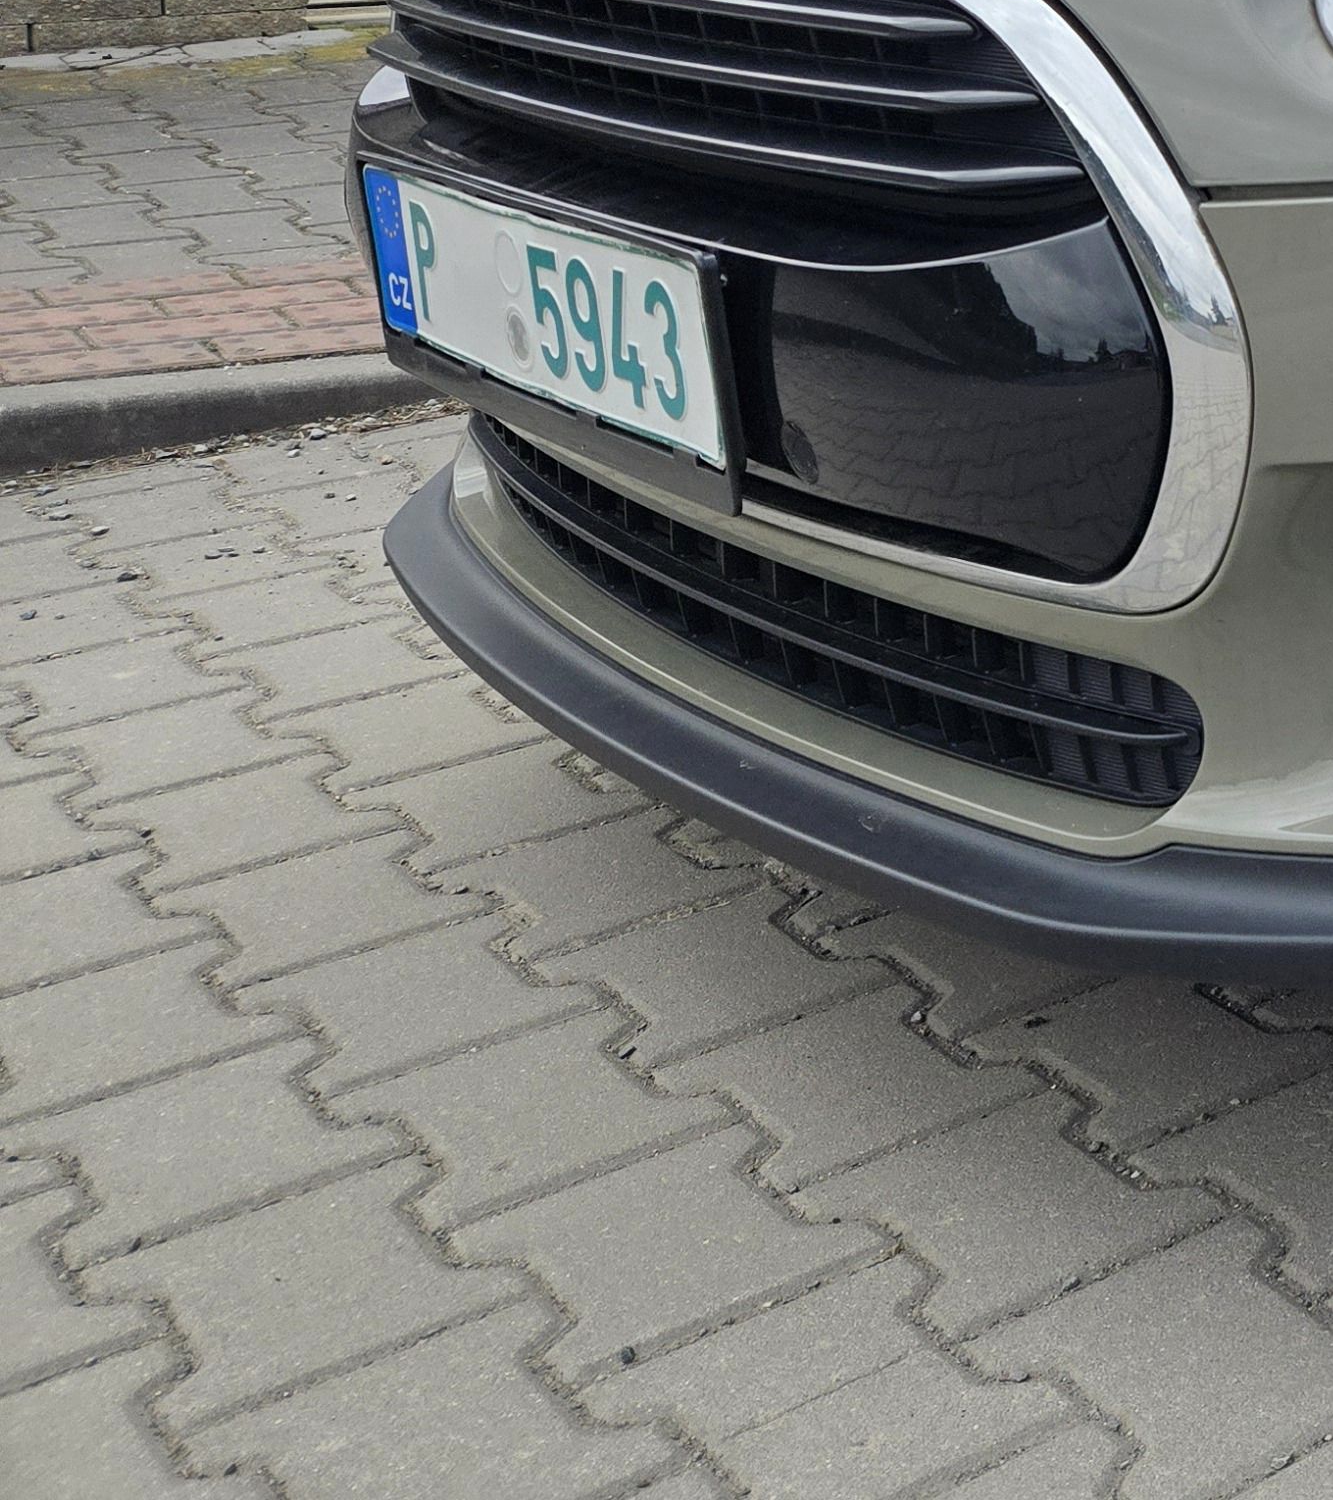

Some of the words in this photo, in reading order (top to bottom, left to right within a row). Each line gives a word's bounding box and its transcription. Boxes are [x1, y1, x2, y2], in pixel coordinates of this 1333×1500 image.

[388, 271, 413, 311] CZ
[409, 200, 436, 323] P
[526, 242, 686, 421] 5943
